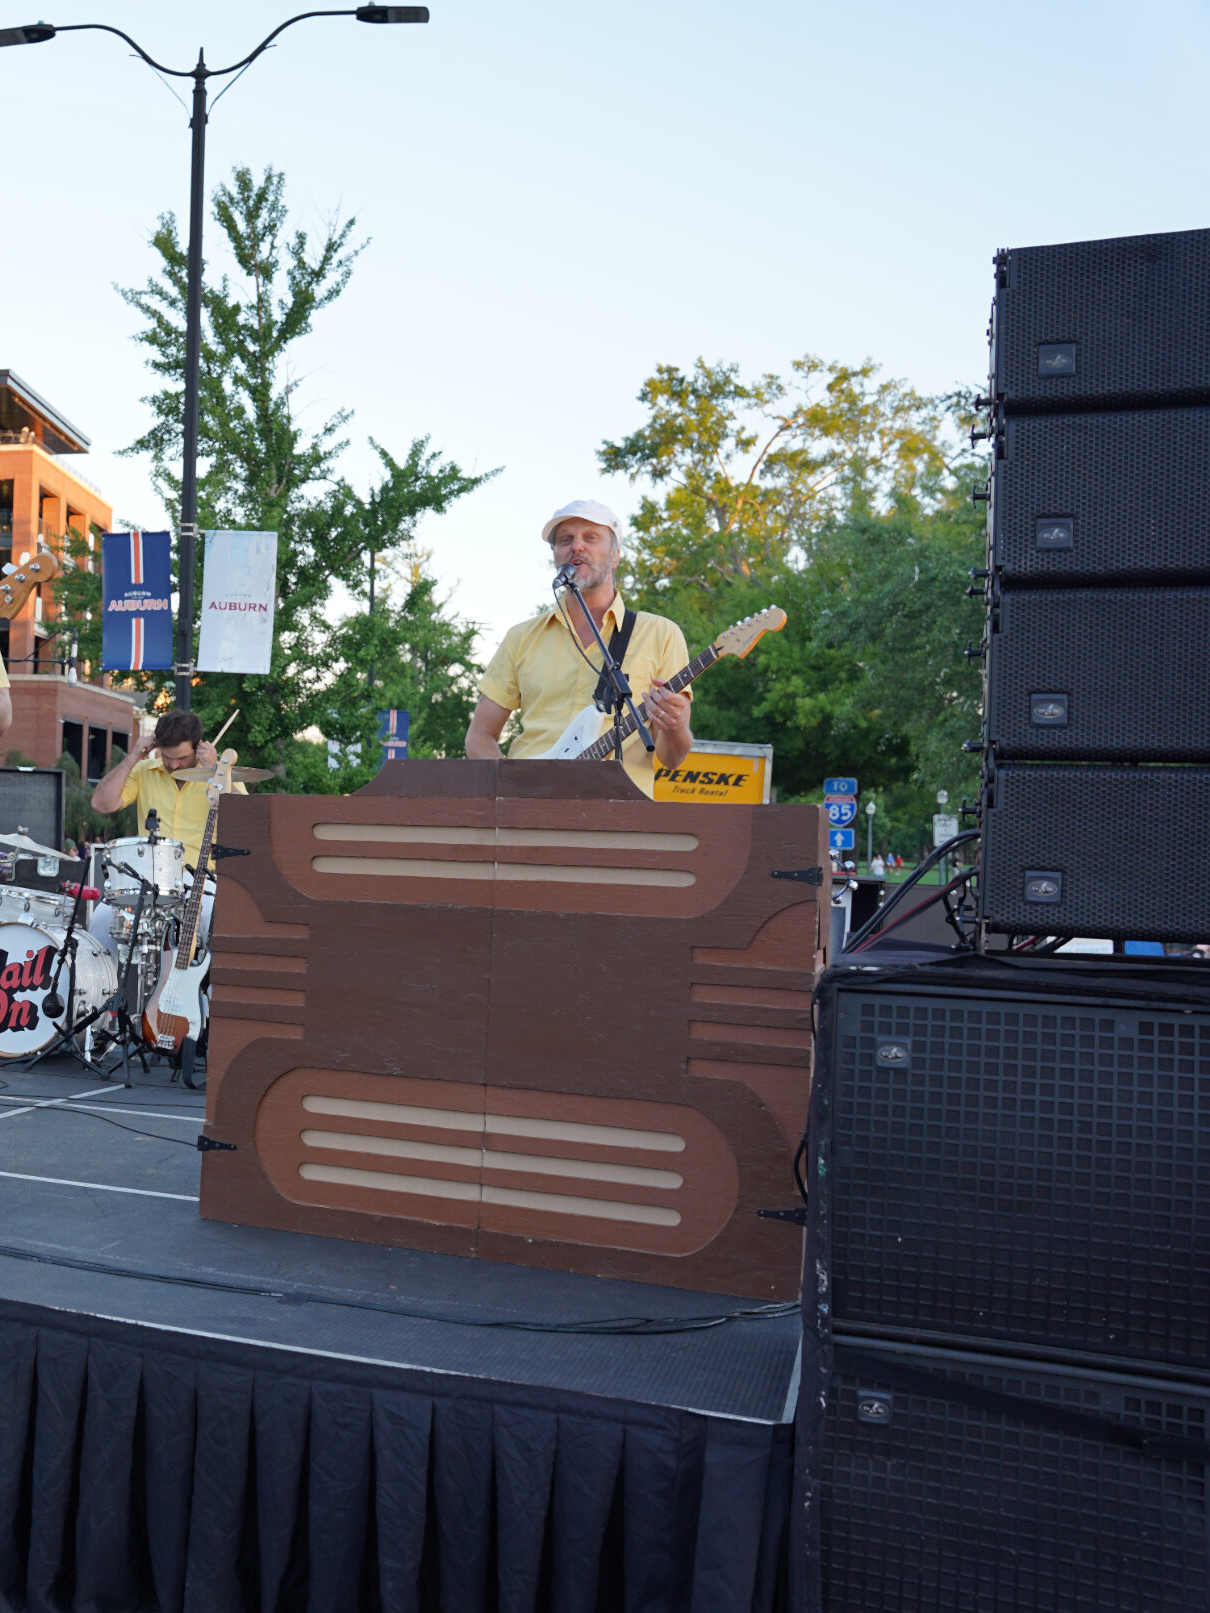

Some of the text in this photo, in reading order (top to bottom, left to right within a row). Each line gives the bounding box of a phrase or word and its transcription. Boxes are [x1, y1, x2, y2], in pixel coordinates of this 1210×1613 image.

[108, 598, 169, 612] AUBURN
[208, 601, 268, 613] AUBURN
[654, 768, 750, 787] PENSKE
[672, 786, 729, 797] Truck Rental
[832, 781, 849, 792] TO
[829, 804, 852, 821] 85
